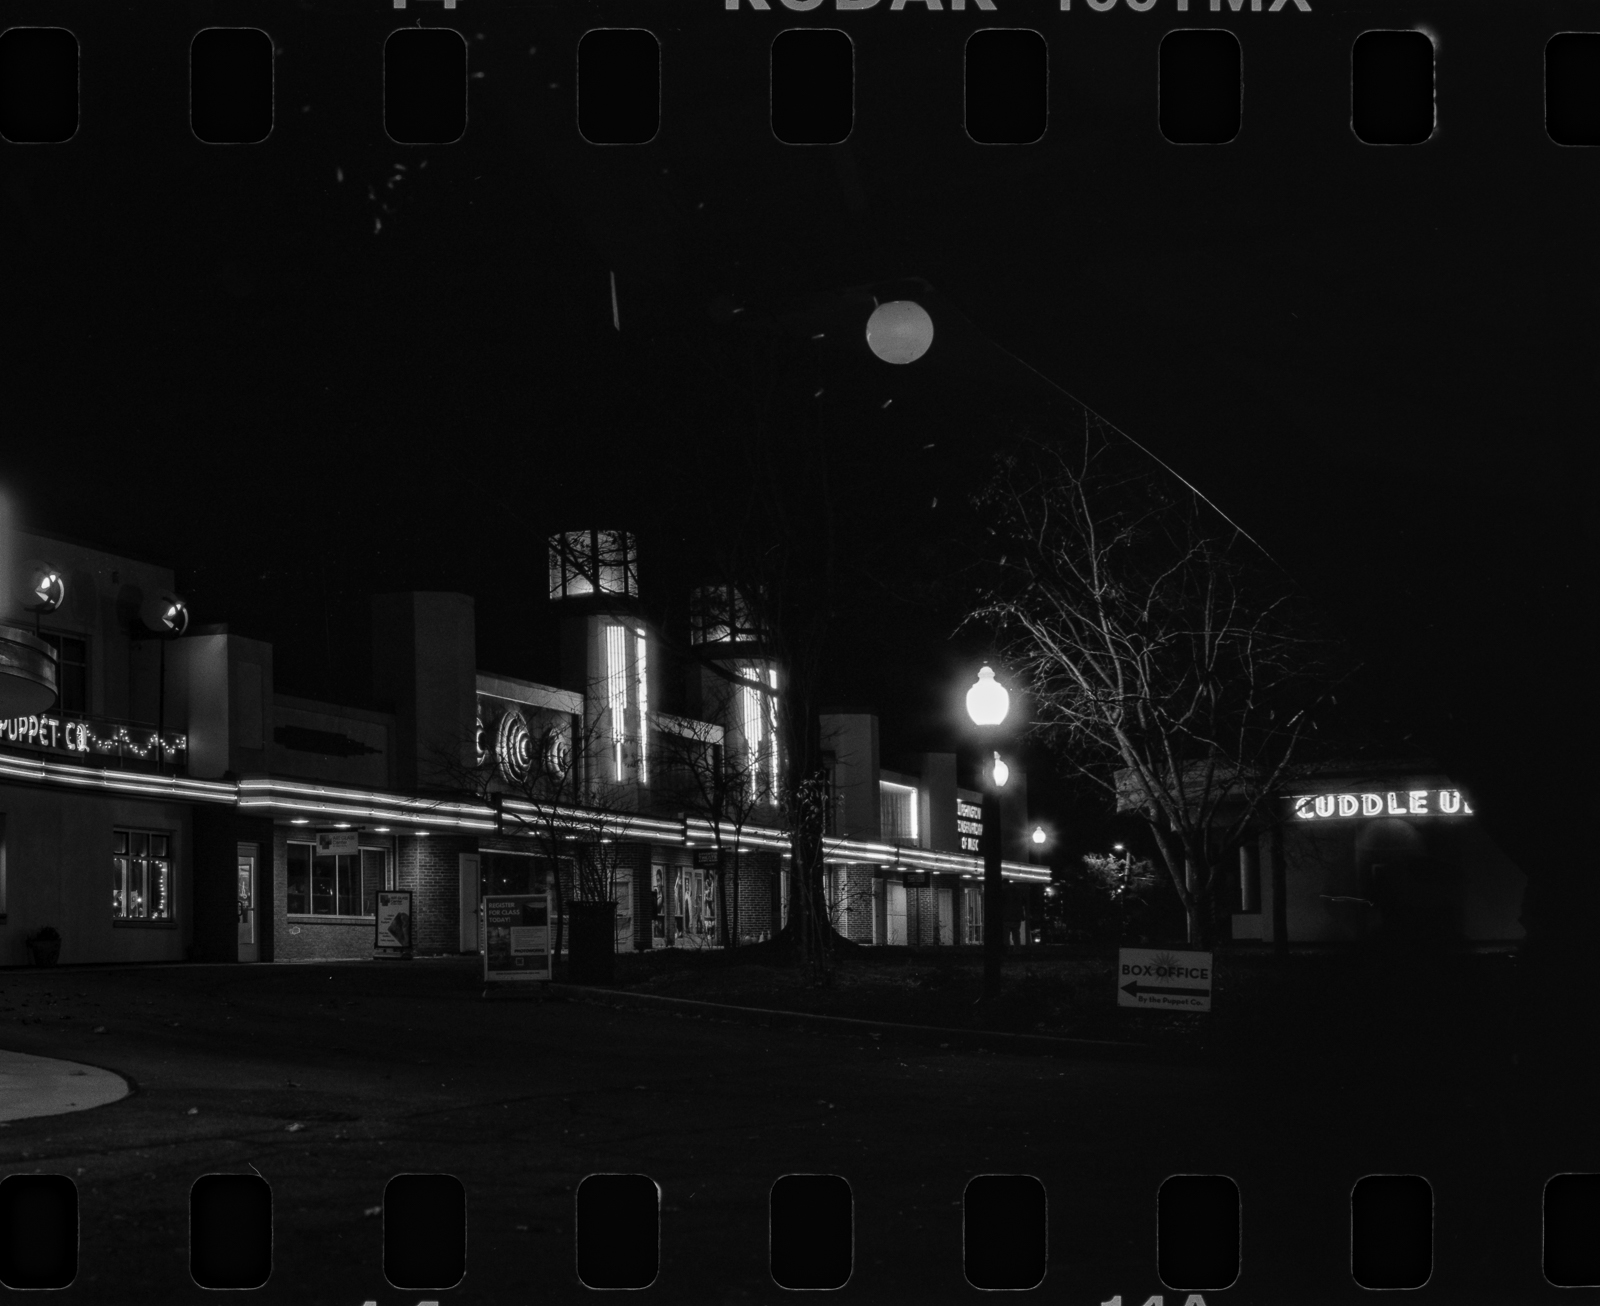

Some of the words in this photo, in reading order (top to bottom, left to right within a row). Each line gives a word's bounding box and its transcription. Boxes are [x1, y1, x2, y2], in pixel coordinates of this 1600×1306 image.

[0, 714, 60, 748] PUPPET
[1295, 791, 1429, 819] CUDDLE
[1439, 790, 1474, 815] U
[1122, 964, 1152, 977] BOX
[1156, 966, 1209, 980] OFFICE
[1138, 995, 1148, 1003] By
[1149, 996, 1163, 1004] the
[1163, 997, 1189, 1006] Puppet
